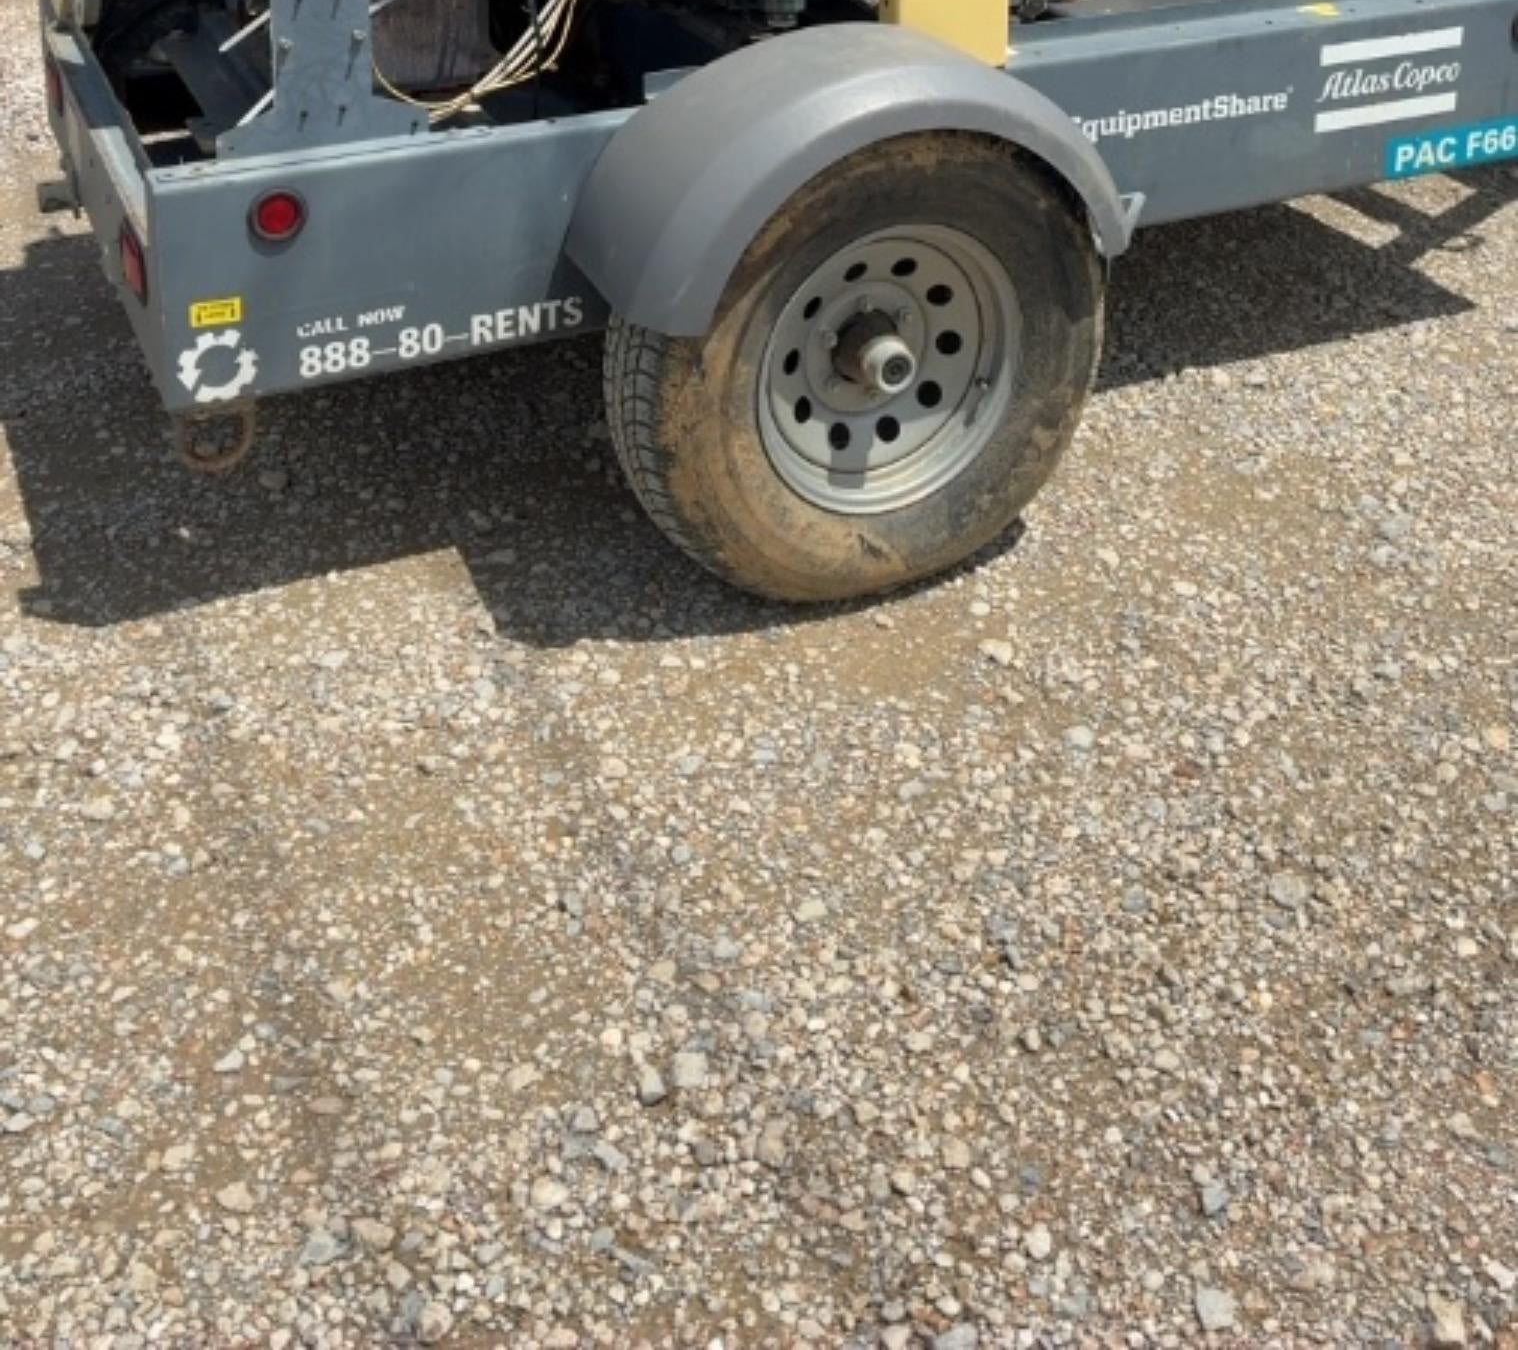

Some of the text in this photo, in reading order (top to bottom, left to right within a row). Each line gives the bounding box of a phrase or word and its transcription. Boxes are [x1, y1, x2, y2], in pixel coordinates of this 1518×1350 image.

[1315, 60, 1462, 103] Atlas Copco
[1071, 92, 1289, 143] quipmentShare
[1394, 124, 1518, 173] PAC F66
[296, 305, 406, 338] CALL NOW
